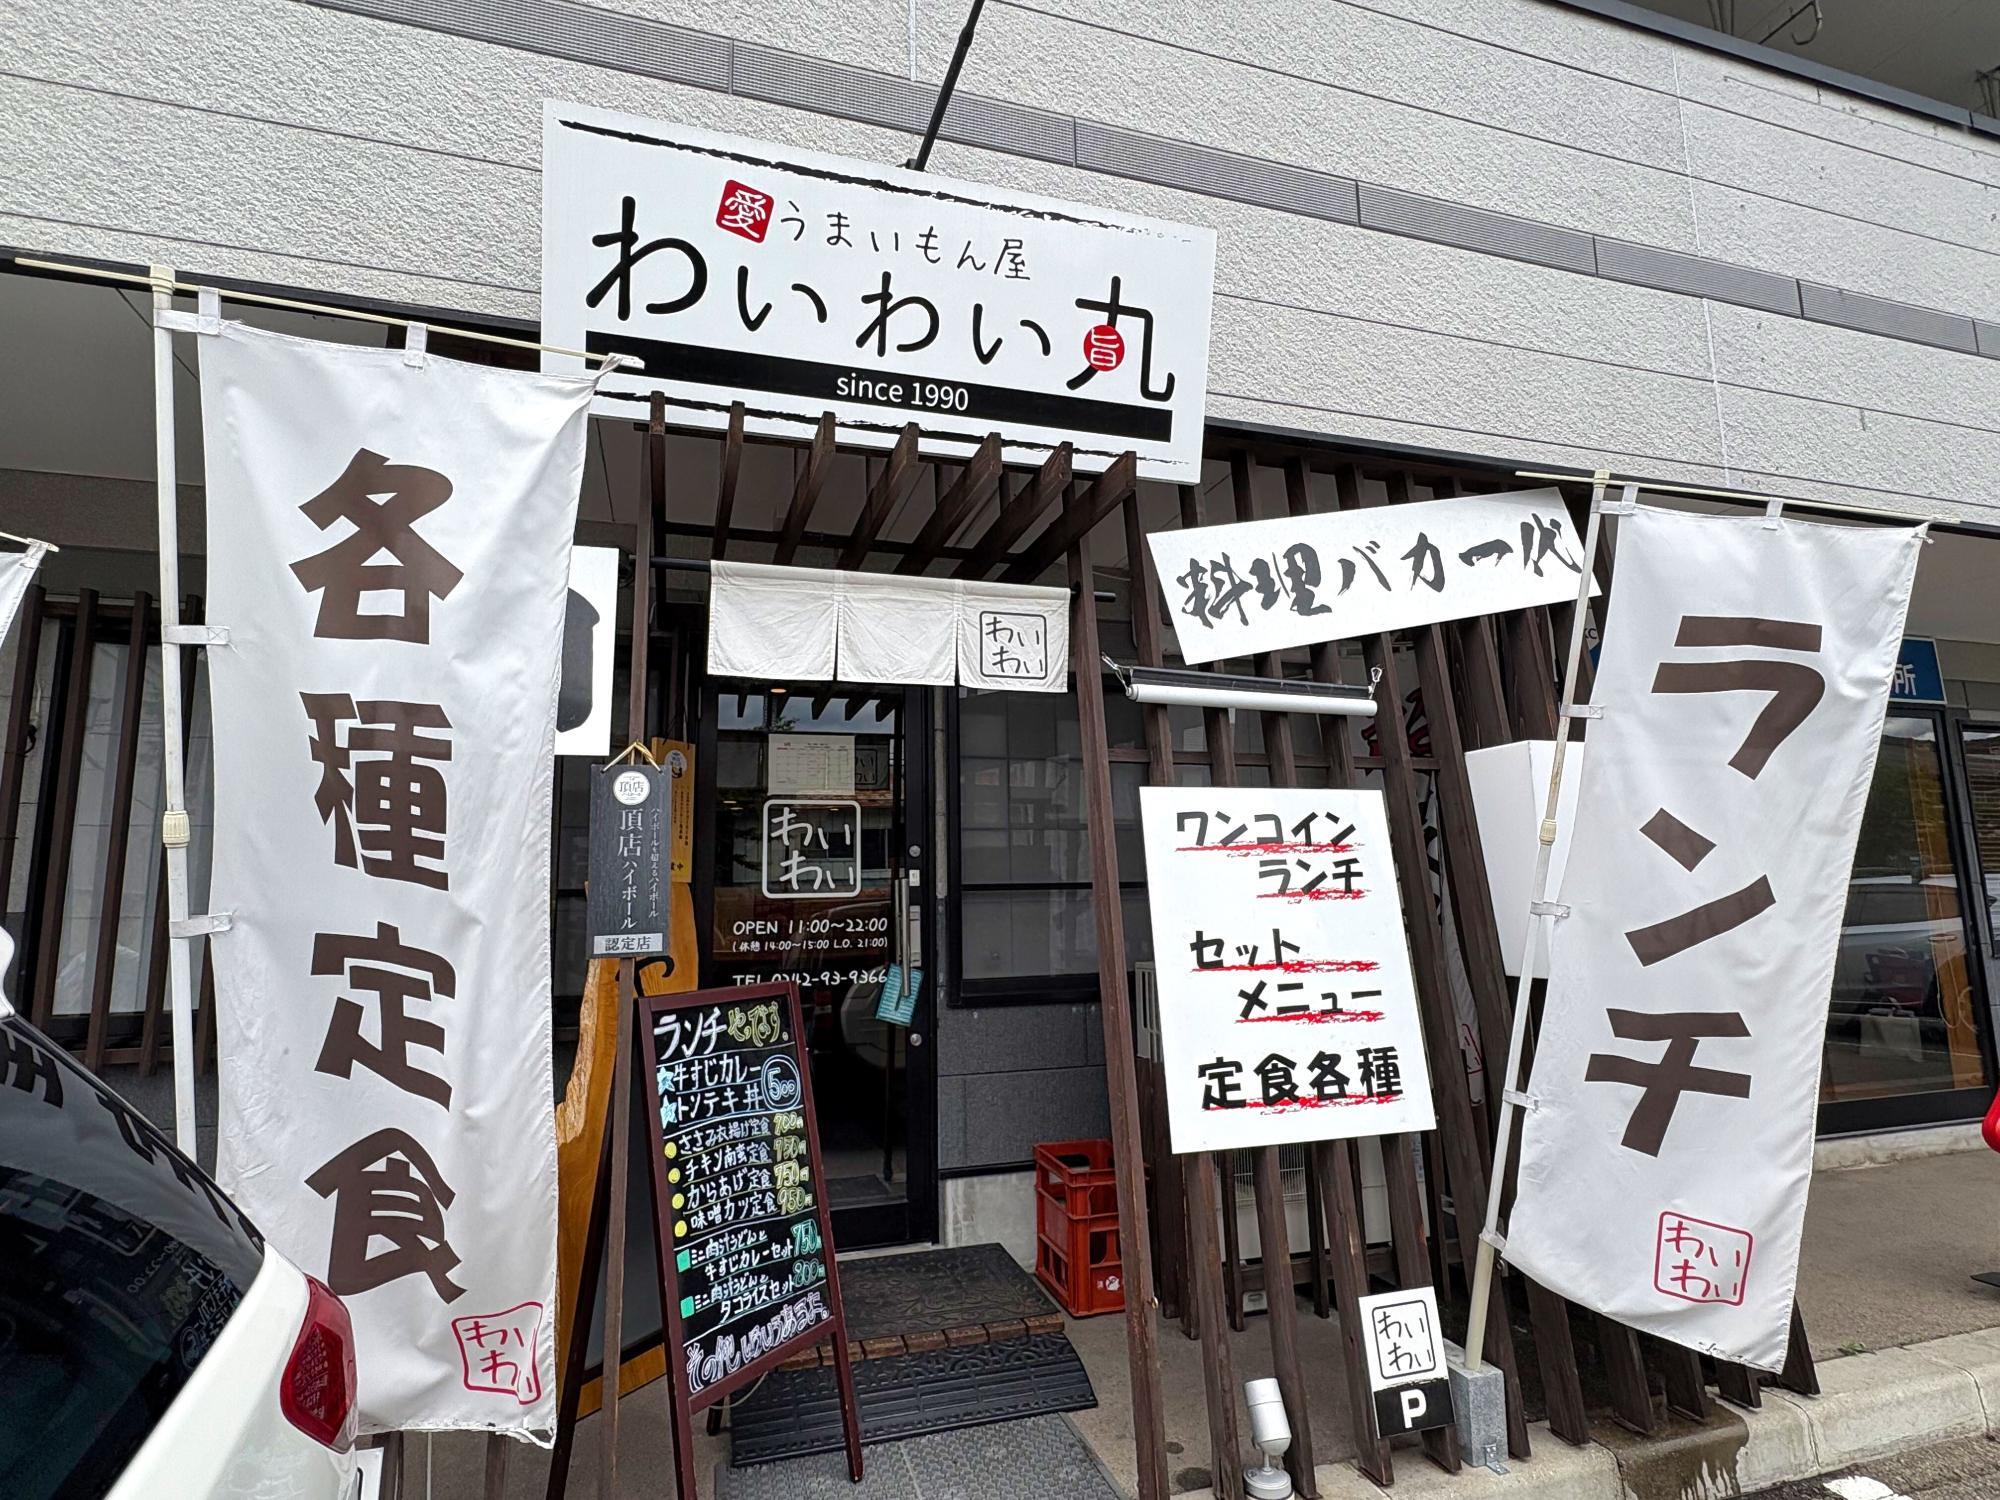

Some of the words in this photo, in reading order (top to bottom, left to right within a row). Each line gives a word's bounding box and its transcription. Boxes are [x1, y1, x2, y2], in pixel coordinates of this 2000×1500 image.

[718, 185, 773, 242] 愛
[779, 200, 1031, 281] うまいもん屋
[836, 372, 903, 404] since
[910, 382, 969, 412] 1990
[1176, 513, 1584, 629] 料理バカ一代
[984, 615, 1040, 647] わい
[992, 645, 1043, 675] わい
[770, 807, 851, 850] わい
[1176, 810, 1358, 848] ワンコイン
[289, 447, 467, 1304] 各種定食
[617, 808, 643, 930] 頂店ハイボール
[779, 850, 854, 890] わい
[1258, 859, 1364, 897] ランチ
[1584, 615, 1825, 1158] ランチ
[604, 936, 652, 951] 認定店
[733, 920, 778, 935] OPEN
[1189, 928, 1300, 970] セット
[1238, 979, 1383, 1019] メニュー
[673, 1053, 761, 1091] 牛すじカレー
[767, 1066, 796, 1100] 500
[1200, 1046, 1402, 1110] 定食各種
[677, 1083, 763, 1121] トンテキ丼
[678, 1116, 771, 1155] ささみ衣揚げ定食
[685, 1141, 772, 1182] チキン南蛮定食
[687, 1167, 774, 1209] からあげ定食
[690, 1191, 778, 1229] 味噌カツ定食
[705, 1238, 794, 1281] 牛すじカレーセット
[1664, 1221, 1742, 1267] わい
[1671, 1259, 1738, 1300] わい
[1379, 1309, 1427, 1339] わい
[1387, 1340, 1433, 1372] わい
[1401, 1388, 1427, 1429] P
